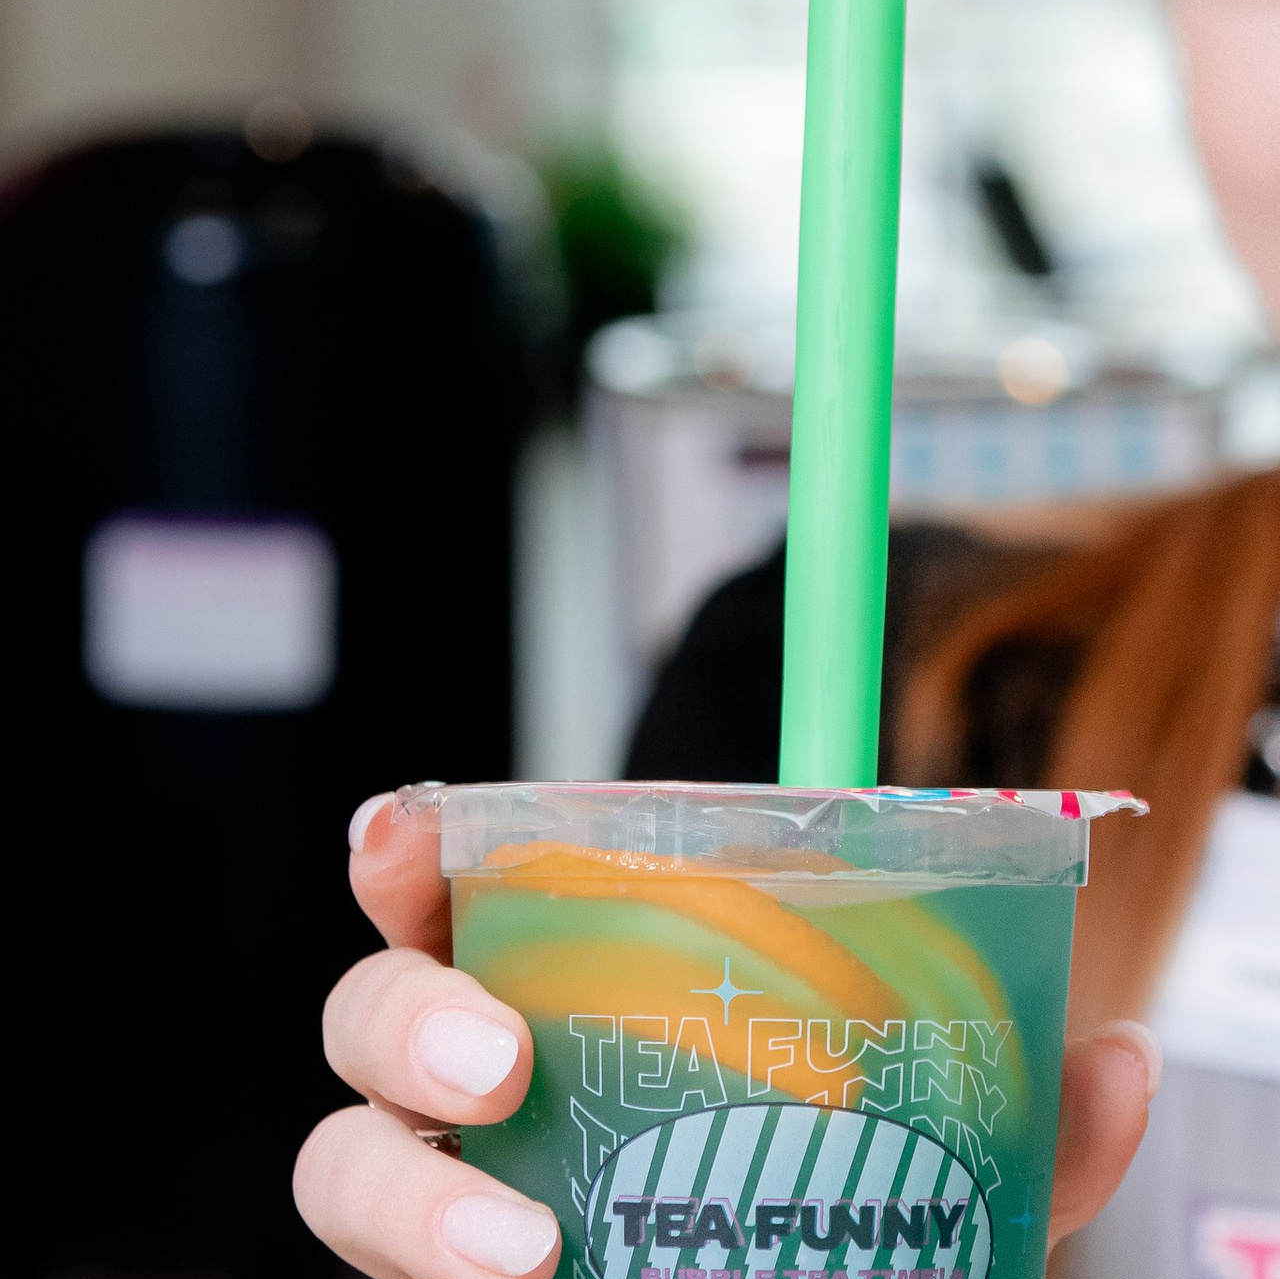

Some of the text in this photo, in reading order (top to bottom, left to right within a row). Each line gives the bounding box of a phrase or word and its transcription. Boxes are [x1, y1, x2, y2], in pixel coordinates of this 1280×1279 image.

[569, 1014, 1014, 1112] TEA FUNNY
[612, 1196, 970, 1252] TEA FUNNY
